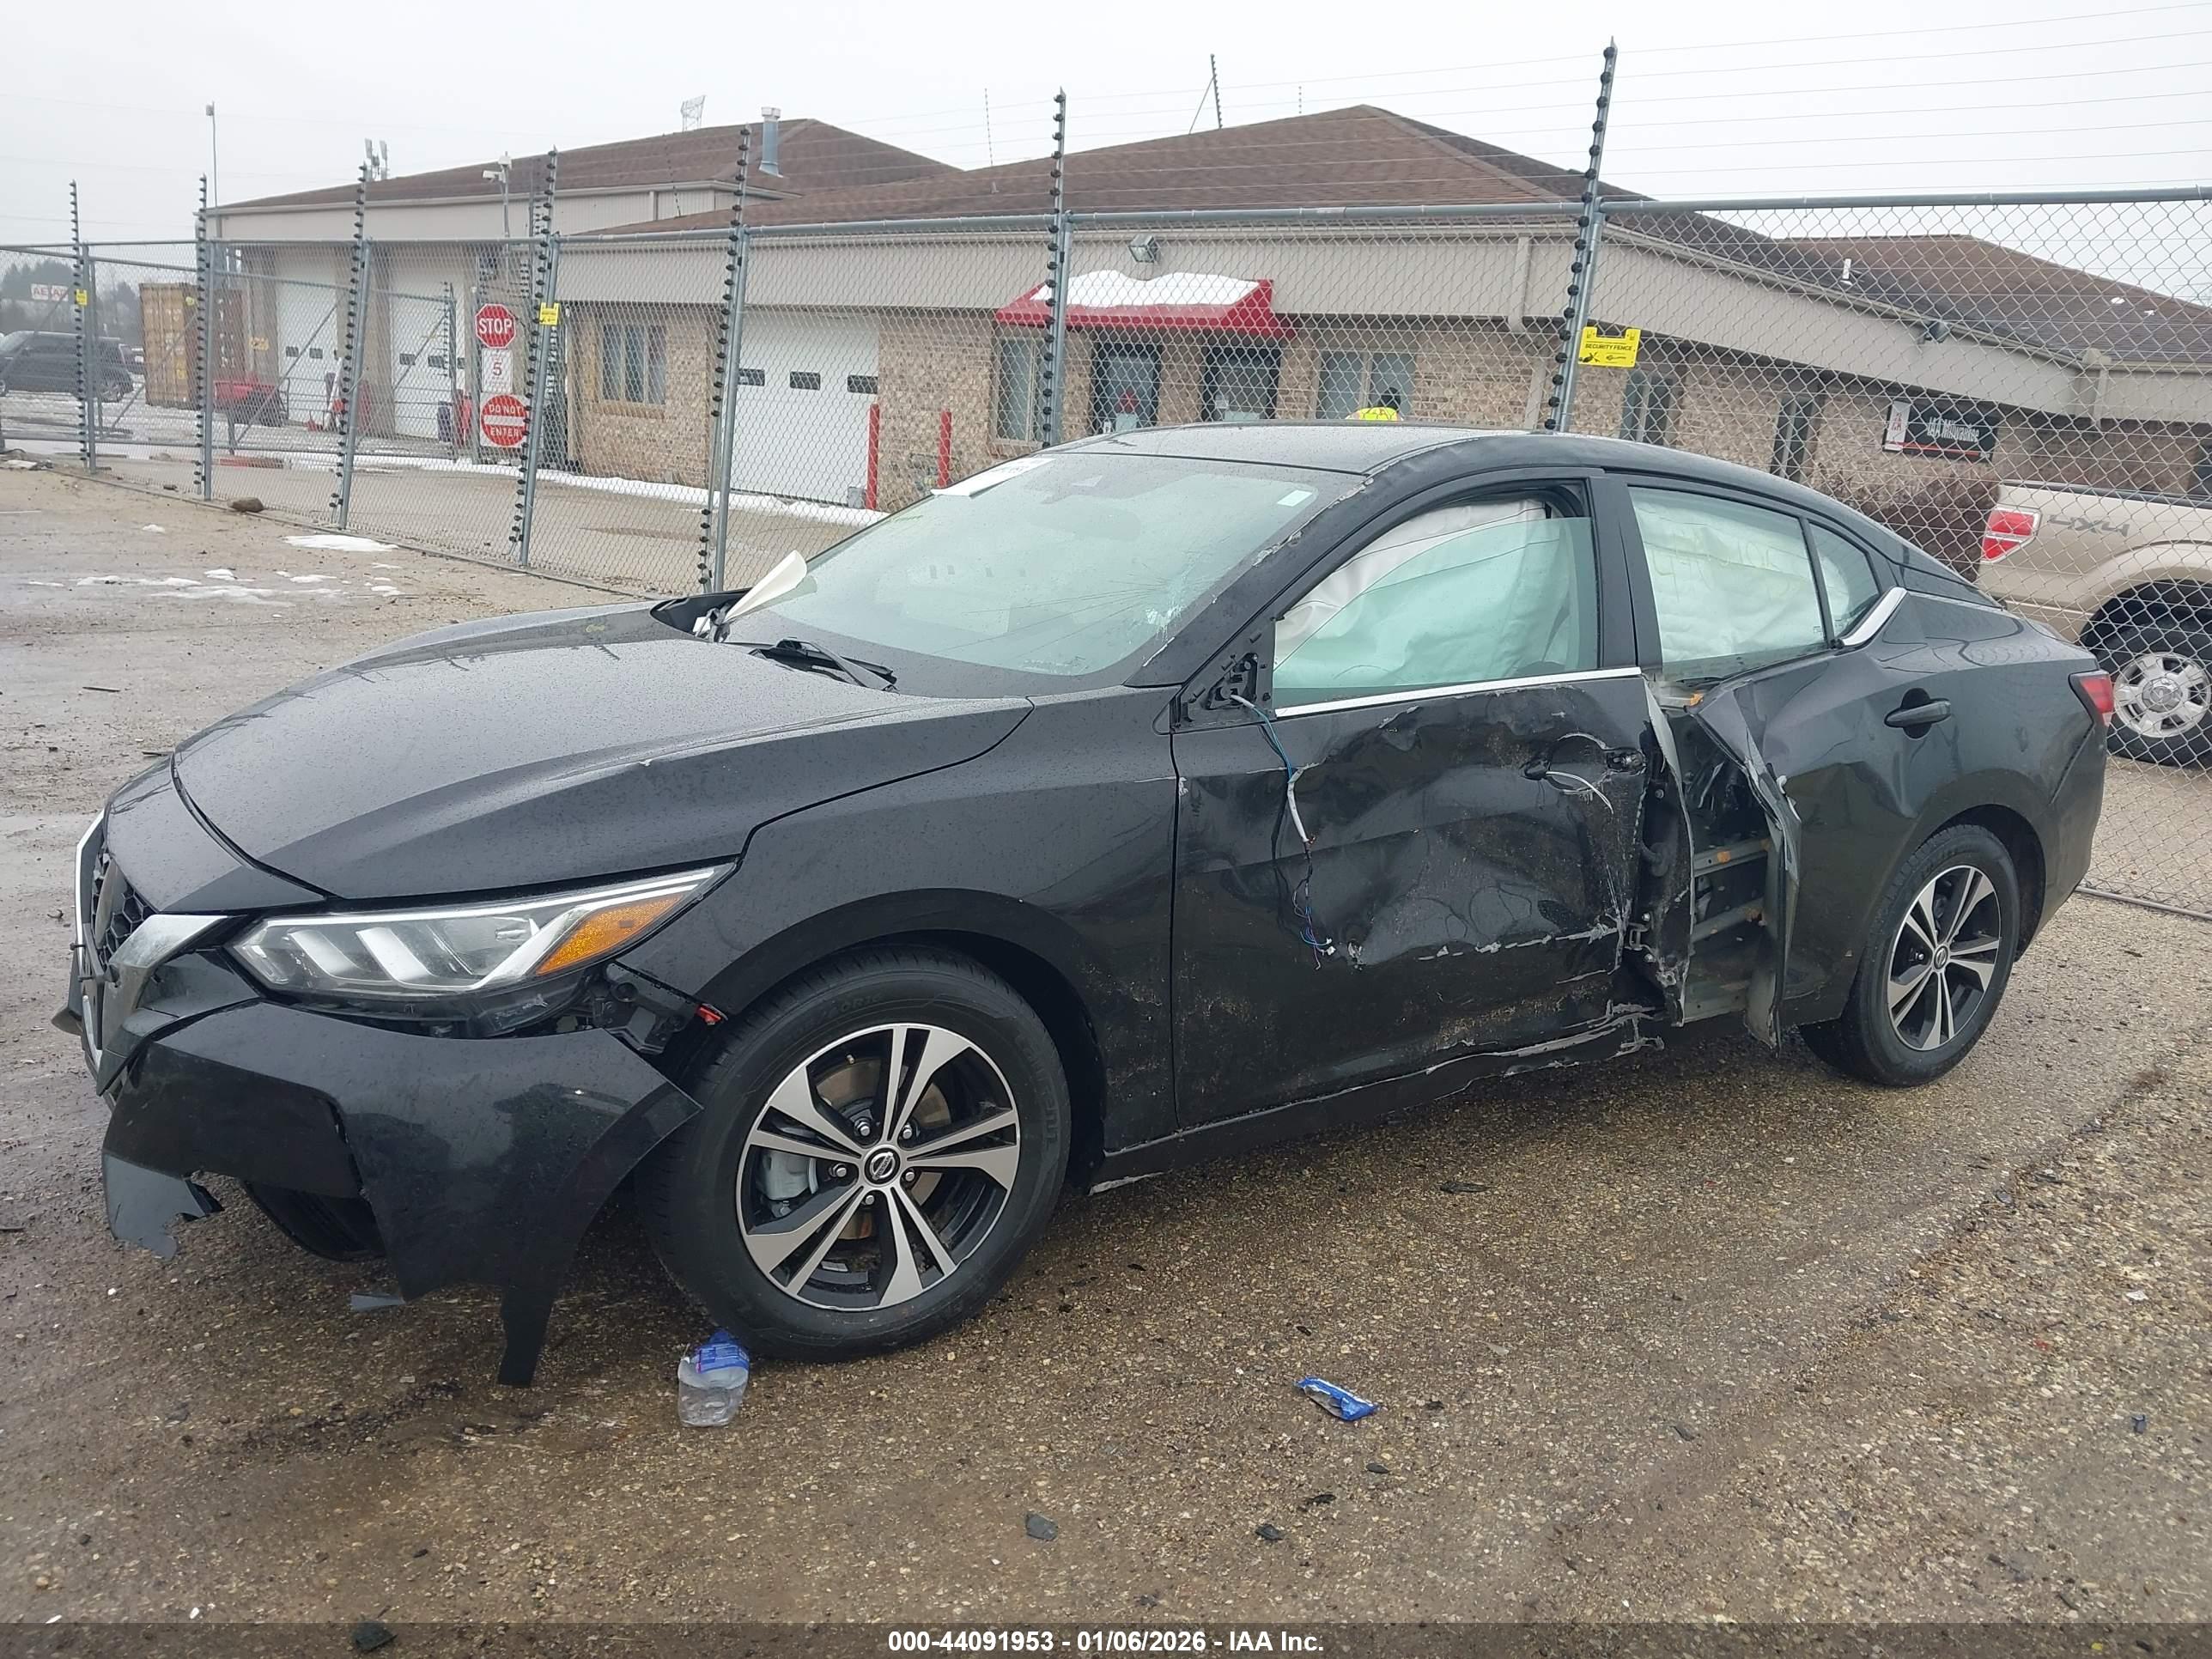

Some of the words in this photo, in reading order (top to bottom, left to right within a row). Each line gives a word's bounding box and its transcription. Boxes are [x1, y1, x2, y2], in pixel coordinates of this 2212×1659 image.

[479, 318, 513, 334] STOP
[493, 362, 502, 376] 5
[489, 404, 501, 413] DO
[503, 405, 521, 415] NOT
[490, 427, 519, 437] ENTER
